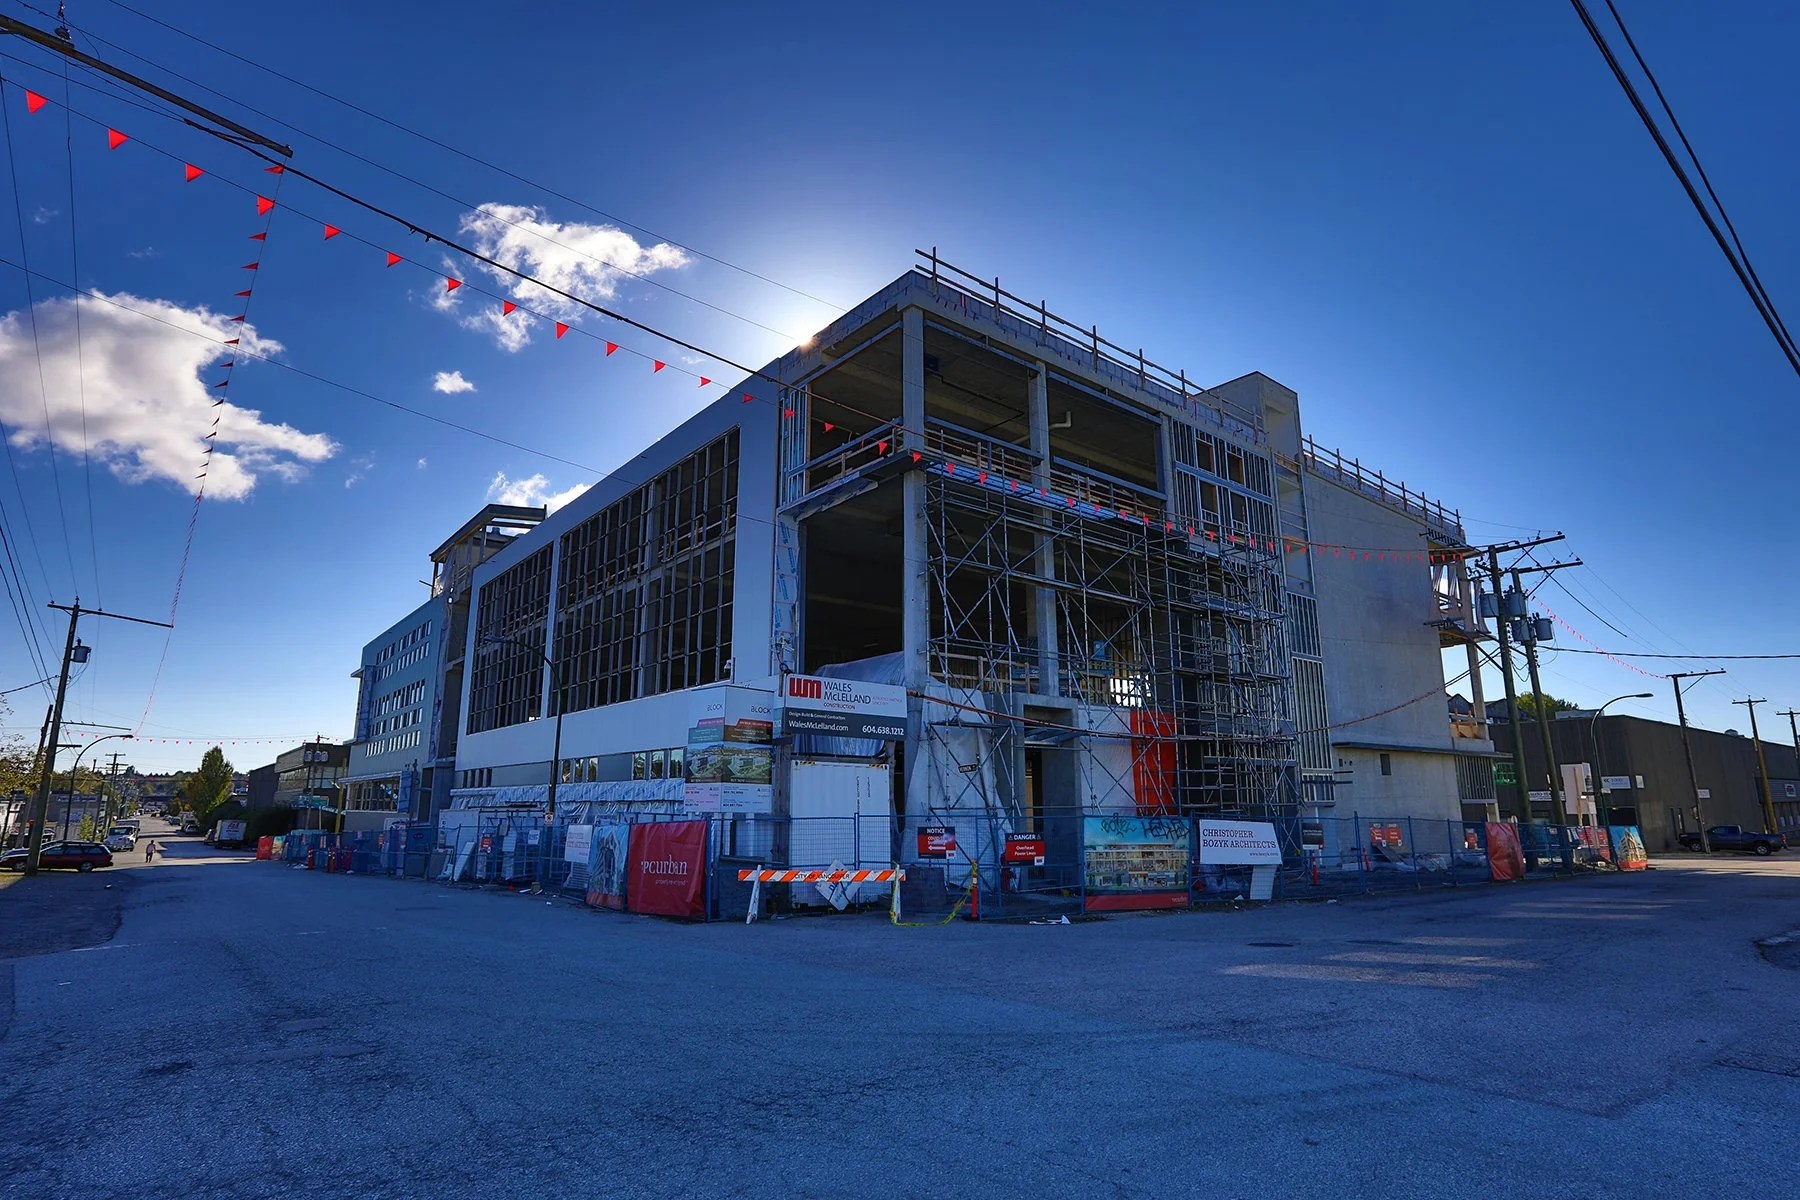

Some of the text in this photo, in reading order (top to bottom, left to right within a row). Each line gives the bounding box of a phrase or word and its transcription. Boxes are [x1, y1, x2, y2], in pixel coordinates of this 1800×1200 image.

[823, 681, 852, 692] WALES
[823, 691, 871, 704] McLELLAND
[823, 702, 856, 710] CONSTRUCTION
[788, 720, 849, 732] WalesMcLelland.com
[862, 725, 905, 736] 604.638.1212
[1202, 829, 1254, 838] CHRISTOPHER
[1202, 839, 1277, 849] BOZYK ARCHITECTS
